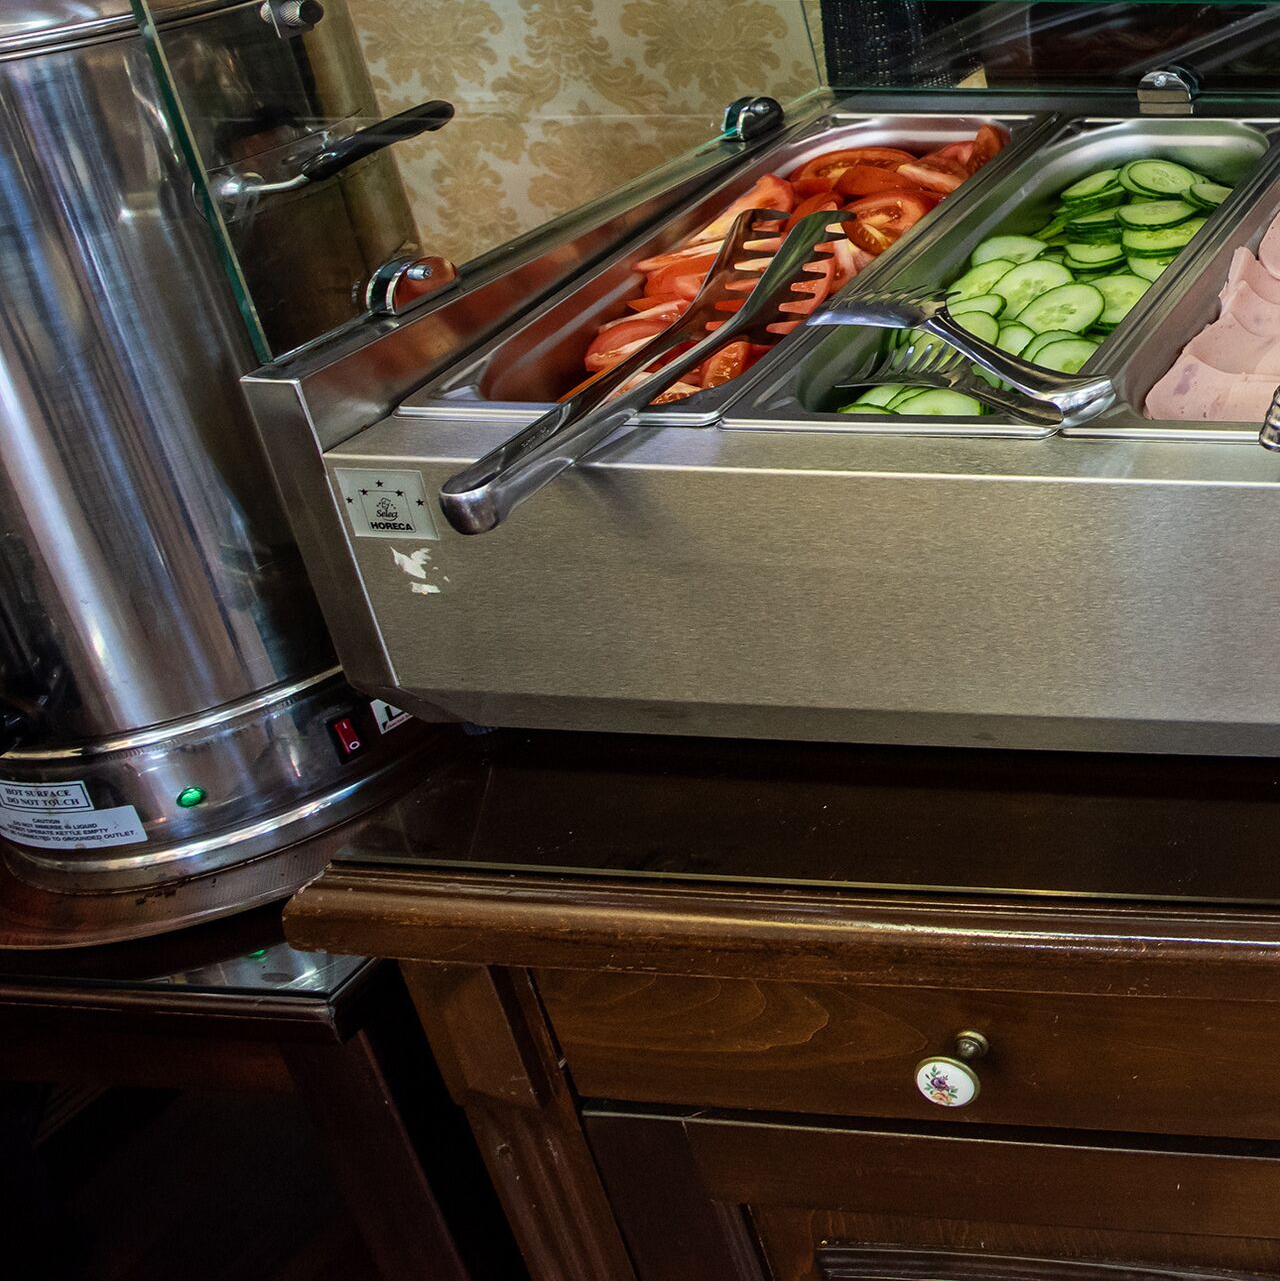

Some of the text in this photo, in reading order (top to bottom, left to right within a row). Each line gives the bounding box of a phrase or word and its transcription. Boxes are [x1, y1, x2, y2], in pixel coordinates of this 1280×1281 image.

[370, 521, 414, 531] HORECA
[5, 788, 71, 798] HOT SURFACE
[6, 796, 20, 805] DO
[42, 798, 80, 807] TOUCH
[26, 828, 55, 836] OPERATE
[62, 834, 103, 842] GROUNDED
[103, 830, 135, 840] OUTLET
